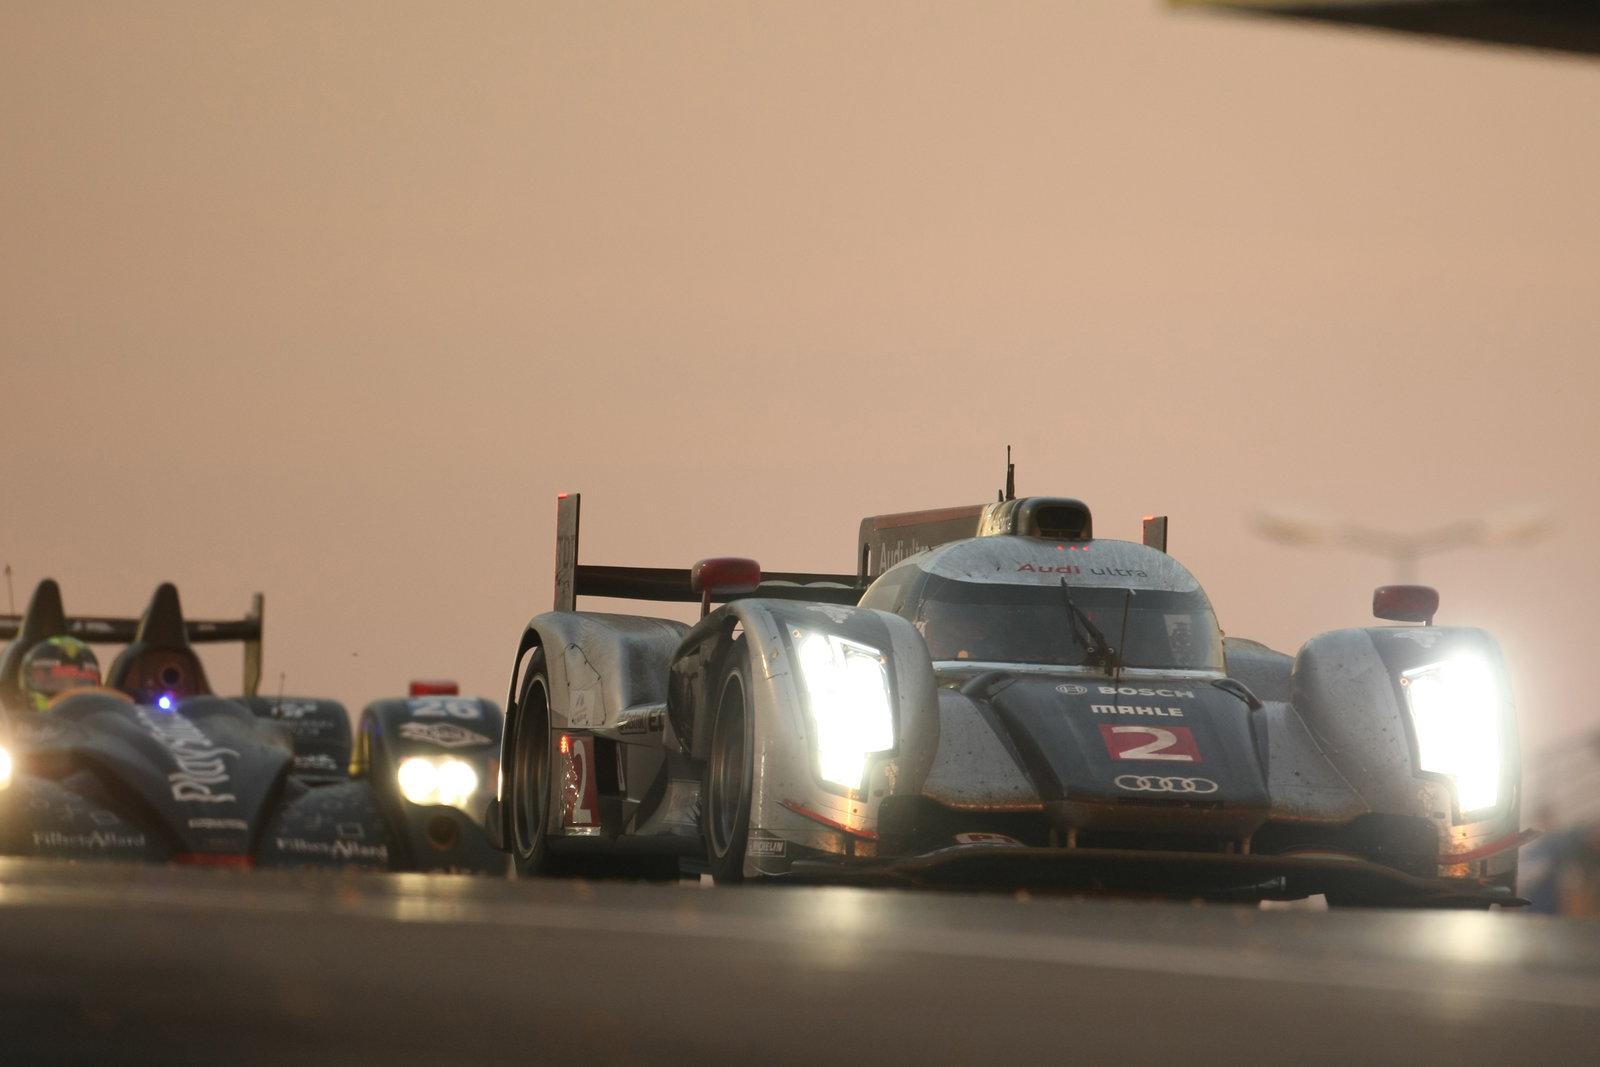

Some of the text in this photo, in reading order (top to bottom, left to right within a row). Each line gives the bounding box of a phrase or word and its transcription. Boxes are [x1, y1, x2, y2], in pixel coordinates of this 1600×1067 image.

[1016, 563, 1148, 578] Audi ultra
[1097, 686, 1195, 699] BOSCH
[411, 697, 481, 720] 26
[1090, 704, 1185, 718] MAHLE
[1111, 725, 1194, 762] 2
